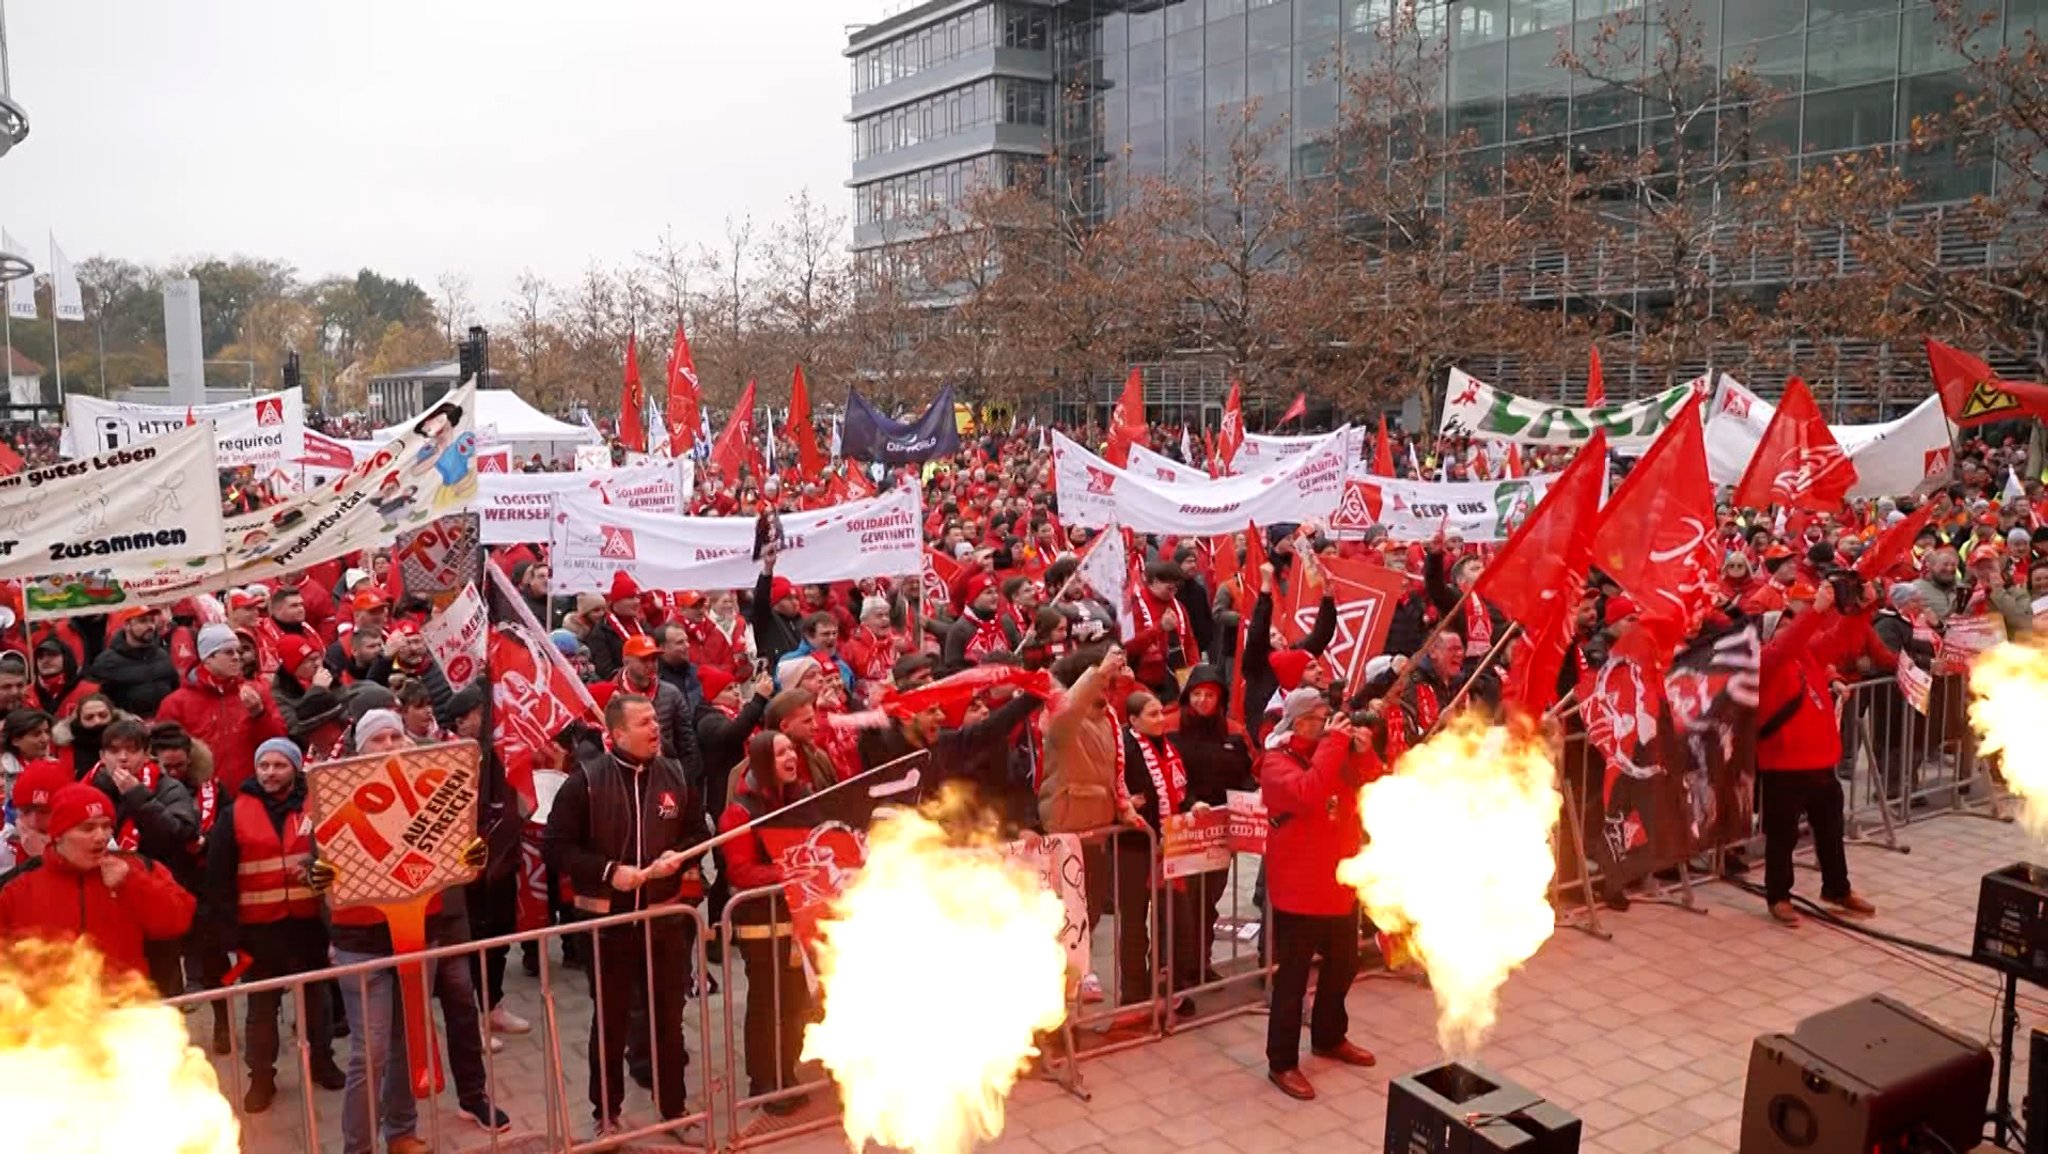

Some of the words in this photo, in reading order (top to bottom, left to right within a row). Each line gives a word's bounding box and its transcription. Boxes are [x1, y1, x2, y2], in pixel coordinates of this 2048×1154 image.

[28, 460, 88, 487] gutes
[93, 446, 156, 471] Leben
[218, 433, 283, 451] required
[1457, 501, 1488, 516] UNS
[315, 757, 450, 863] 7%
[402, 813, 430, 846] AUF
[427, 769, 471, 815] EINEN
[417, 789, 475, 853] STREICH
